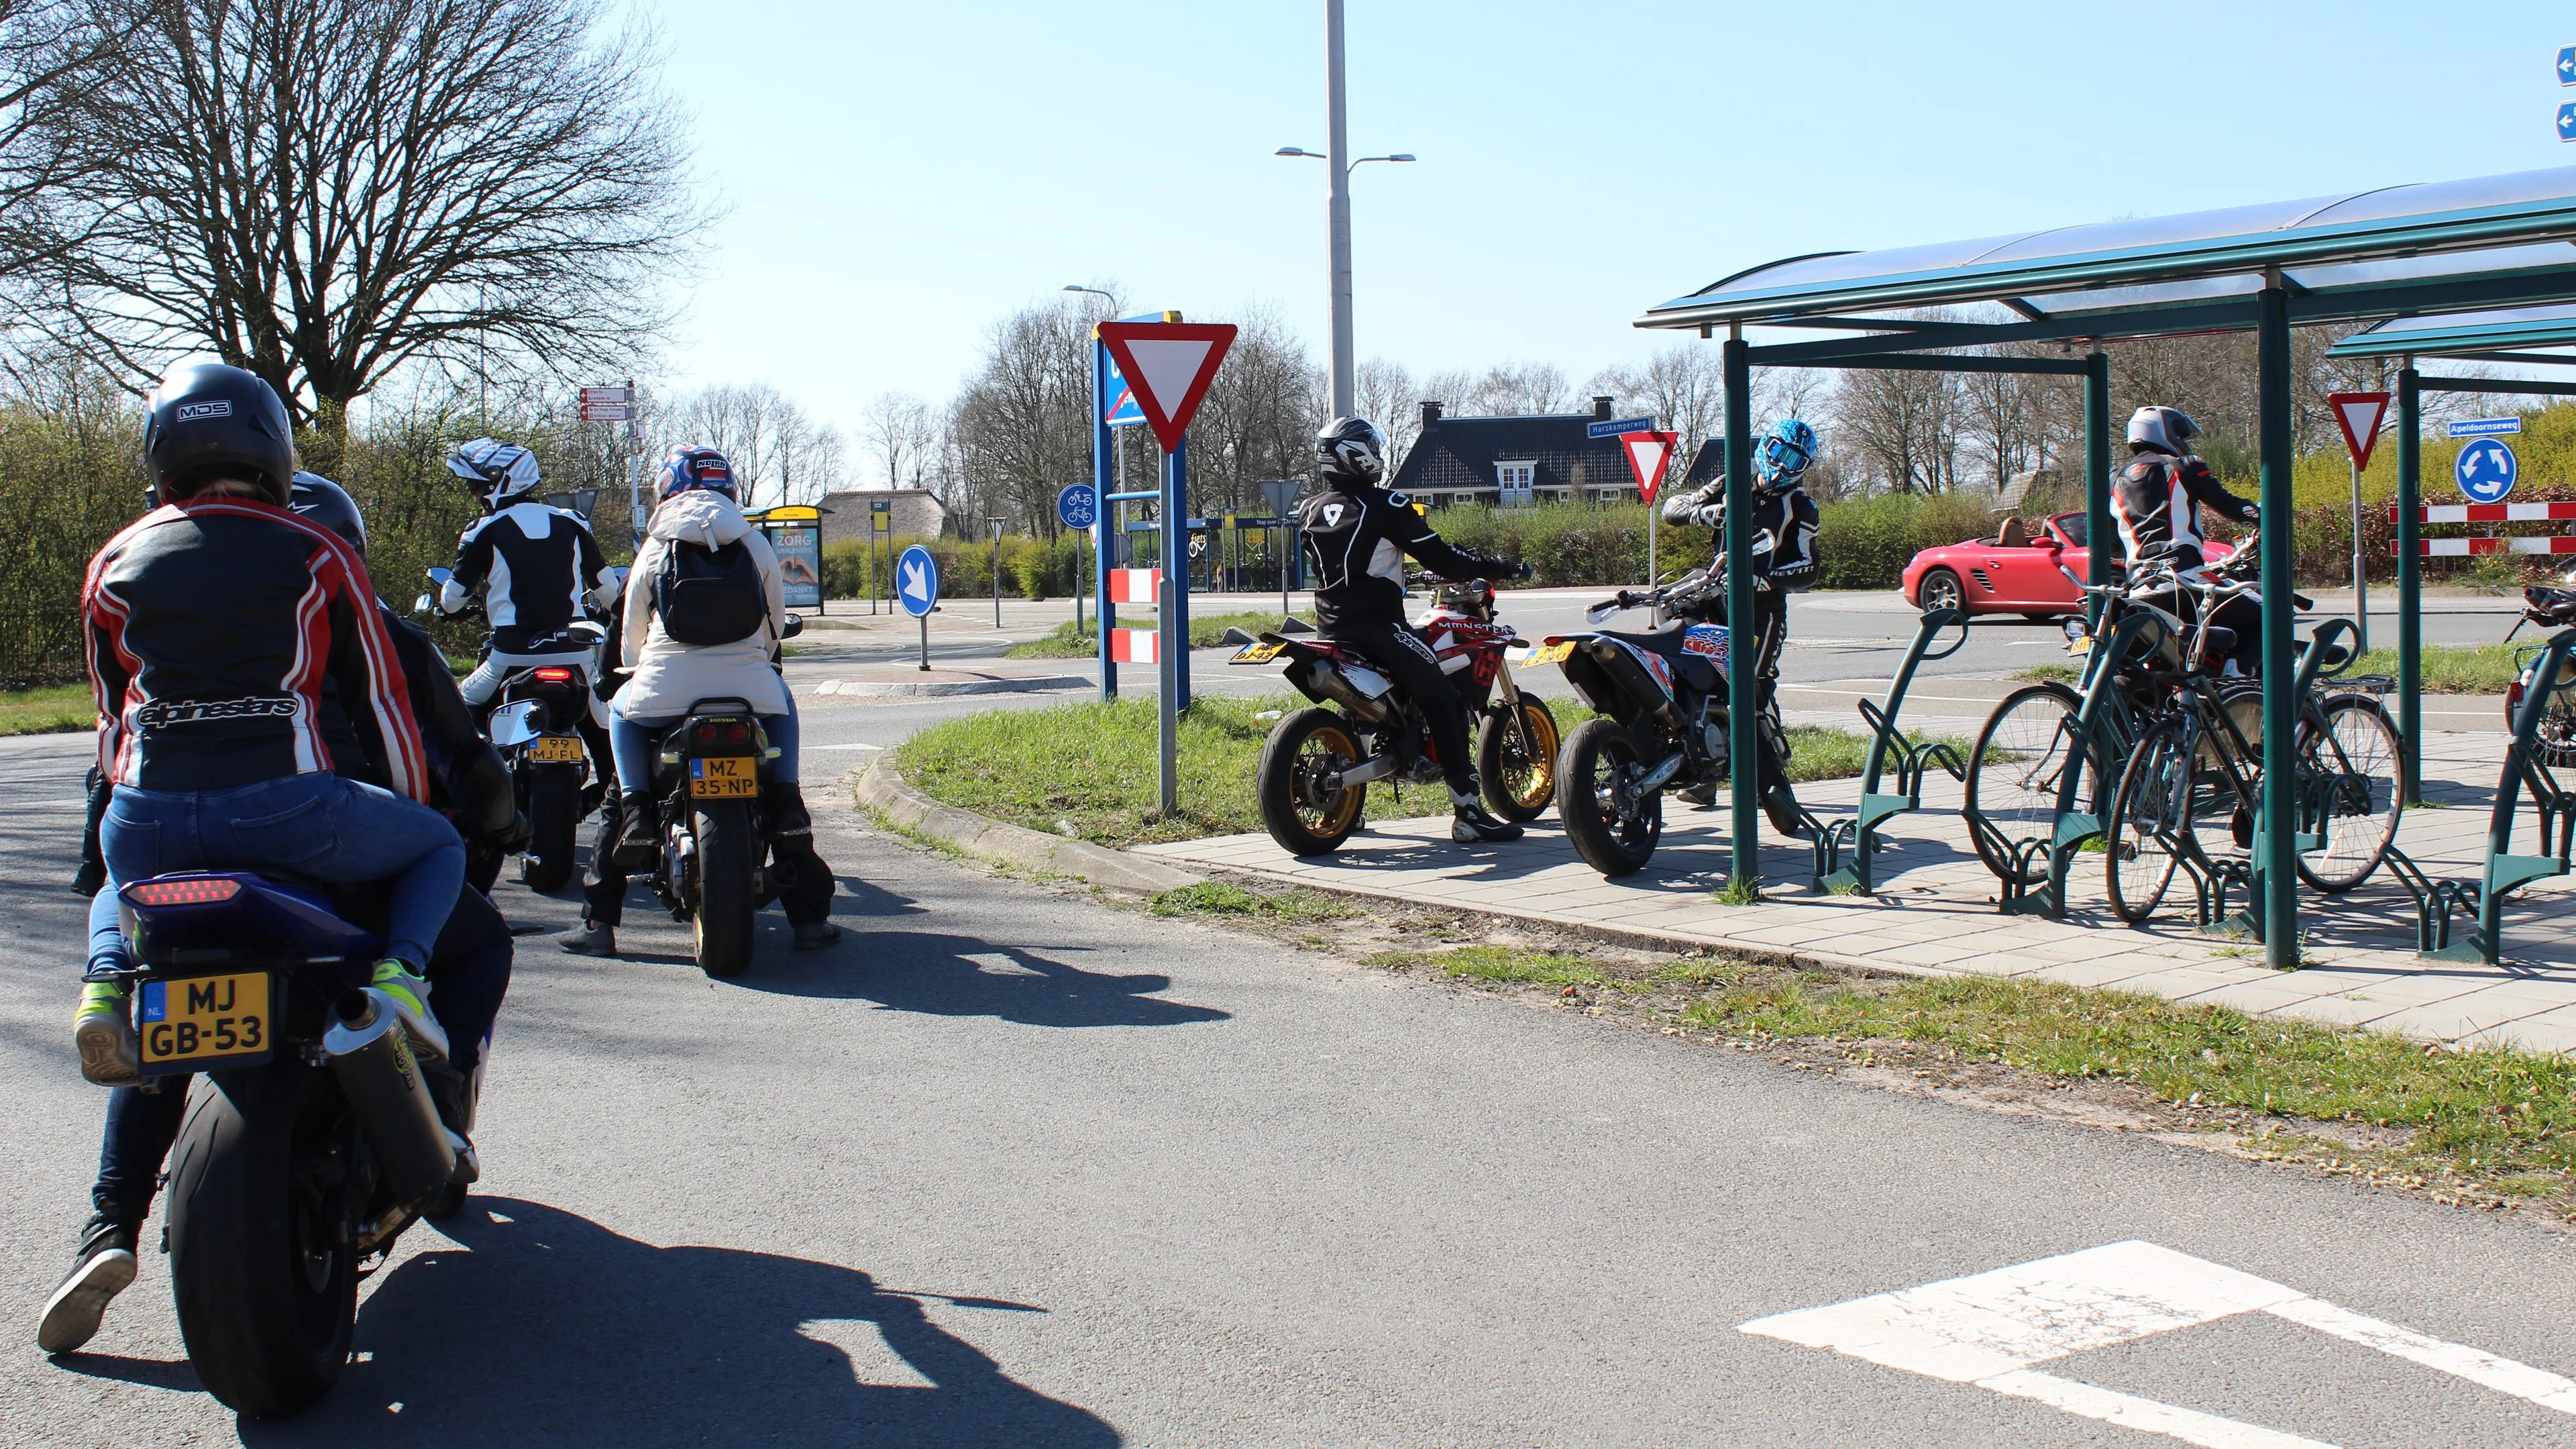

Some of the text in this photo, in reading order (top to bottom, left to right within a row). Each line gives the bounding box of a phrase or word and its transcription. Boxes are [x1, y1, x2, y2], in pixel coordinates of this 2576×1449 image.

[180, 403, 229, 418] MDS
[1592, 421, 1646, 433] Harskamperweg
[2450, 422, 2518, 433] Apeldoornseweg
[777, 535, 812, 546] ZORG
[1769, 566, 1815, 576] REV'IT!
[784, 586, 814, 594] EDANKT
[1235, 651, 1273, 660] DJ-42
[138, 696, 300, 729] alpinestars
[533, 749, 578, 759] MJ-FL
[709, 760, 737, 777] MZ
[696, 779, 753, 795] 35-NP
[188, 979, 235, 1015] MJ
[148, 1007, 162, 1016] NL
[150, 1015, 262, 1057] GB-53
